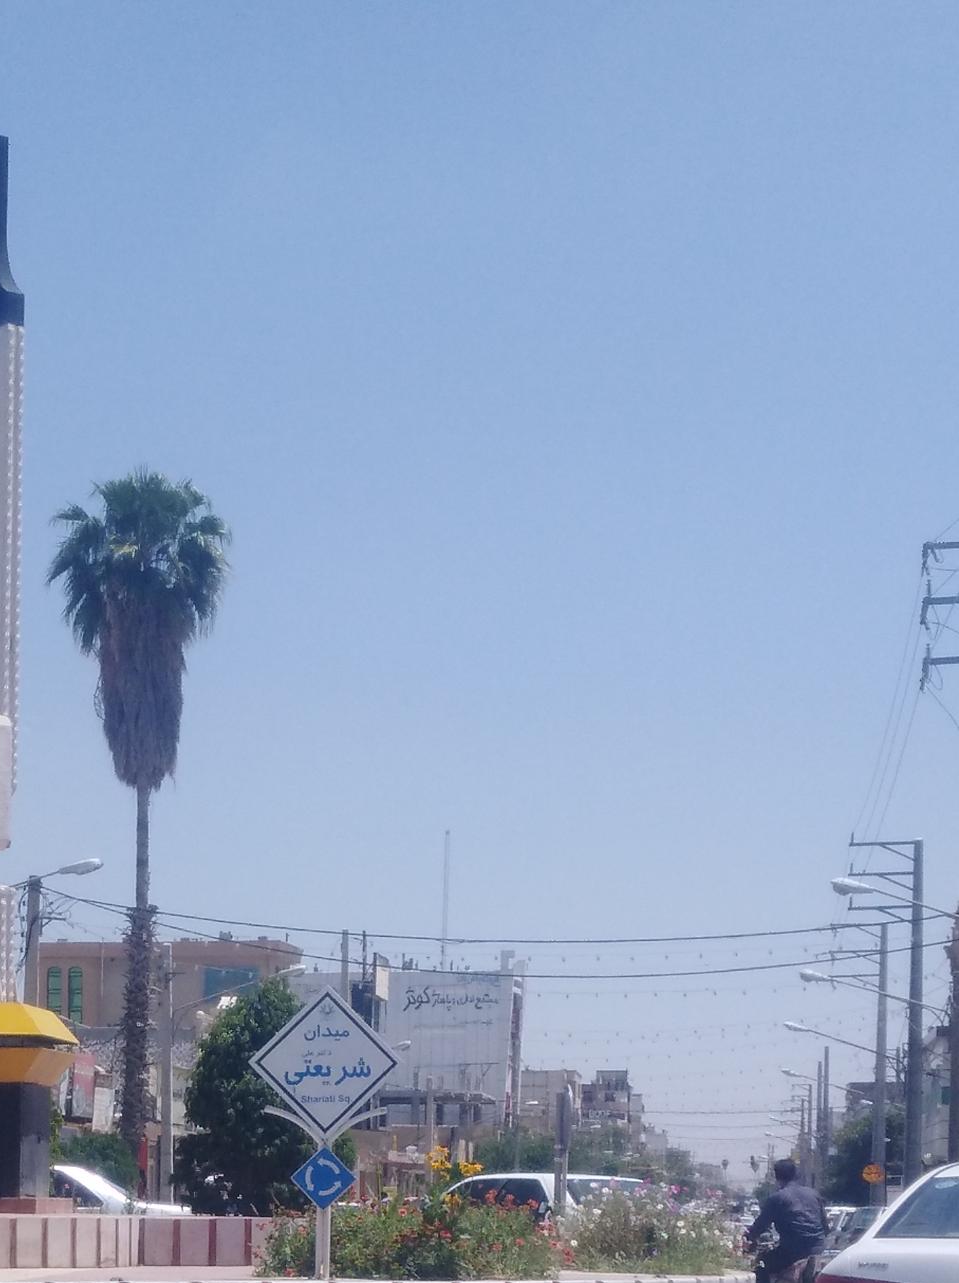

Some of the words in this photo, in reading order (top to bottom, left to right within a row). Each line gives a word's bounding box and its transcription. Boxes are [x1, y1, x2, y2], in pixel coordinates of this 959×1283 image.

[303, 1024, 350, 1041] میدان
[283, 1056, 372, 1086] شریعتی
[300, 1094, 336, 1104] Shariati
[337, 1094, 352, 1105] Sq.
